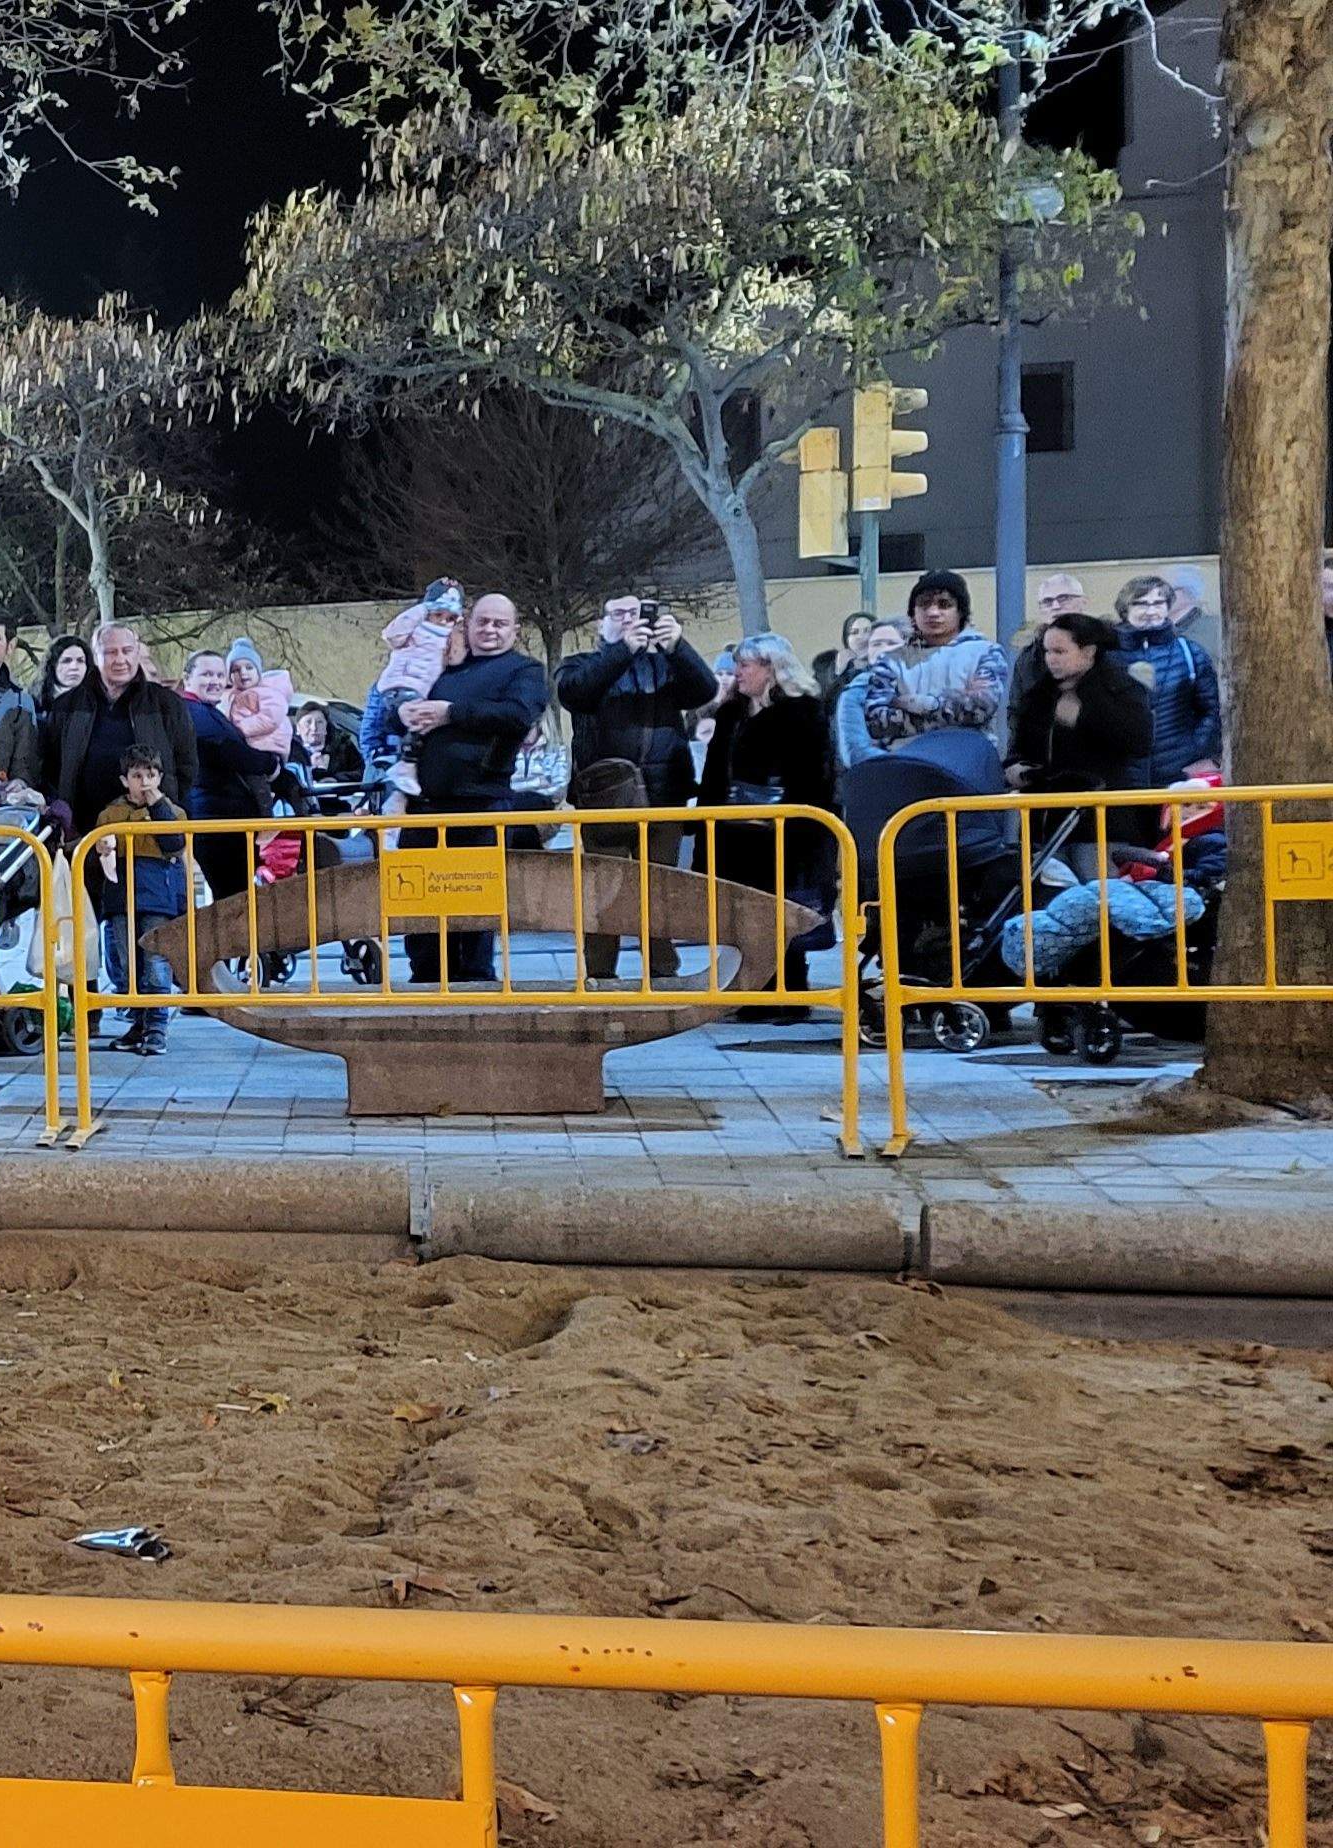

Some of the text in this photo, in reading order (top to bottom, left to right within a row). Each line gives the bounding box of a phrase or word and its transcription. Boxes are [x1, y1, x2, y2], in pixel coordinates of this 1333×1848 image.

[428, 871, 499, 882] Ayuntamiento
[428, 884, 483, 893] de Huesca
